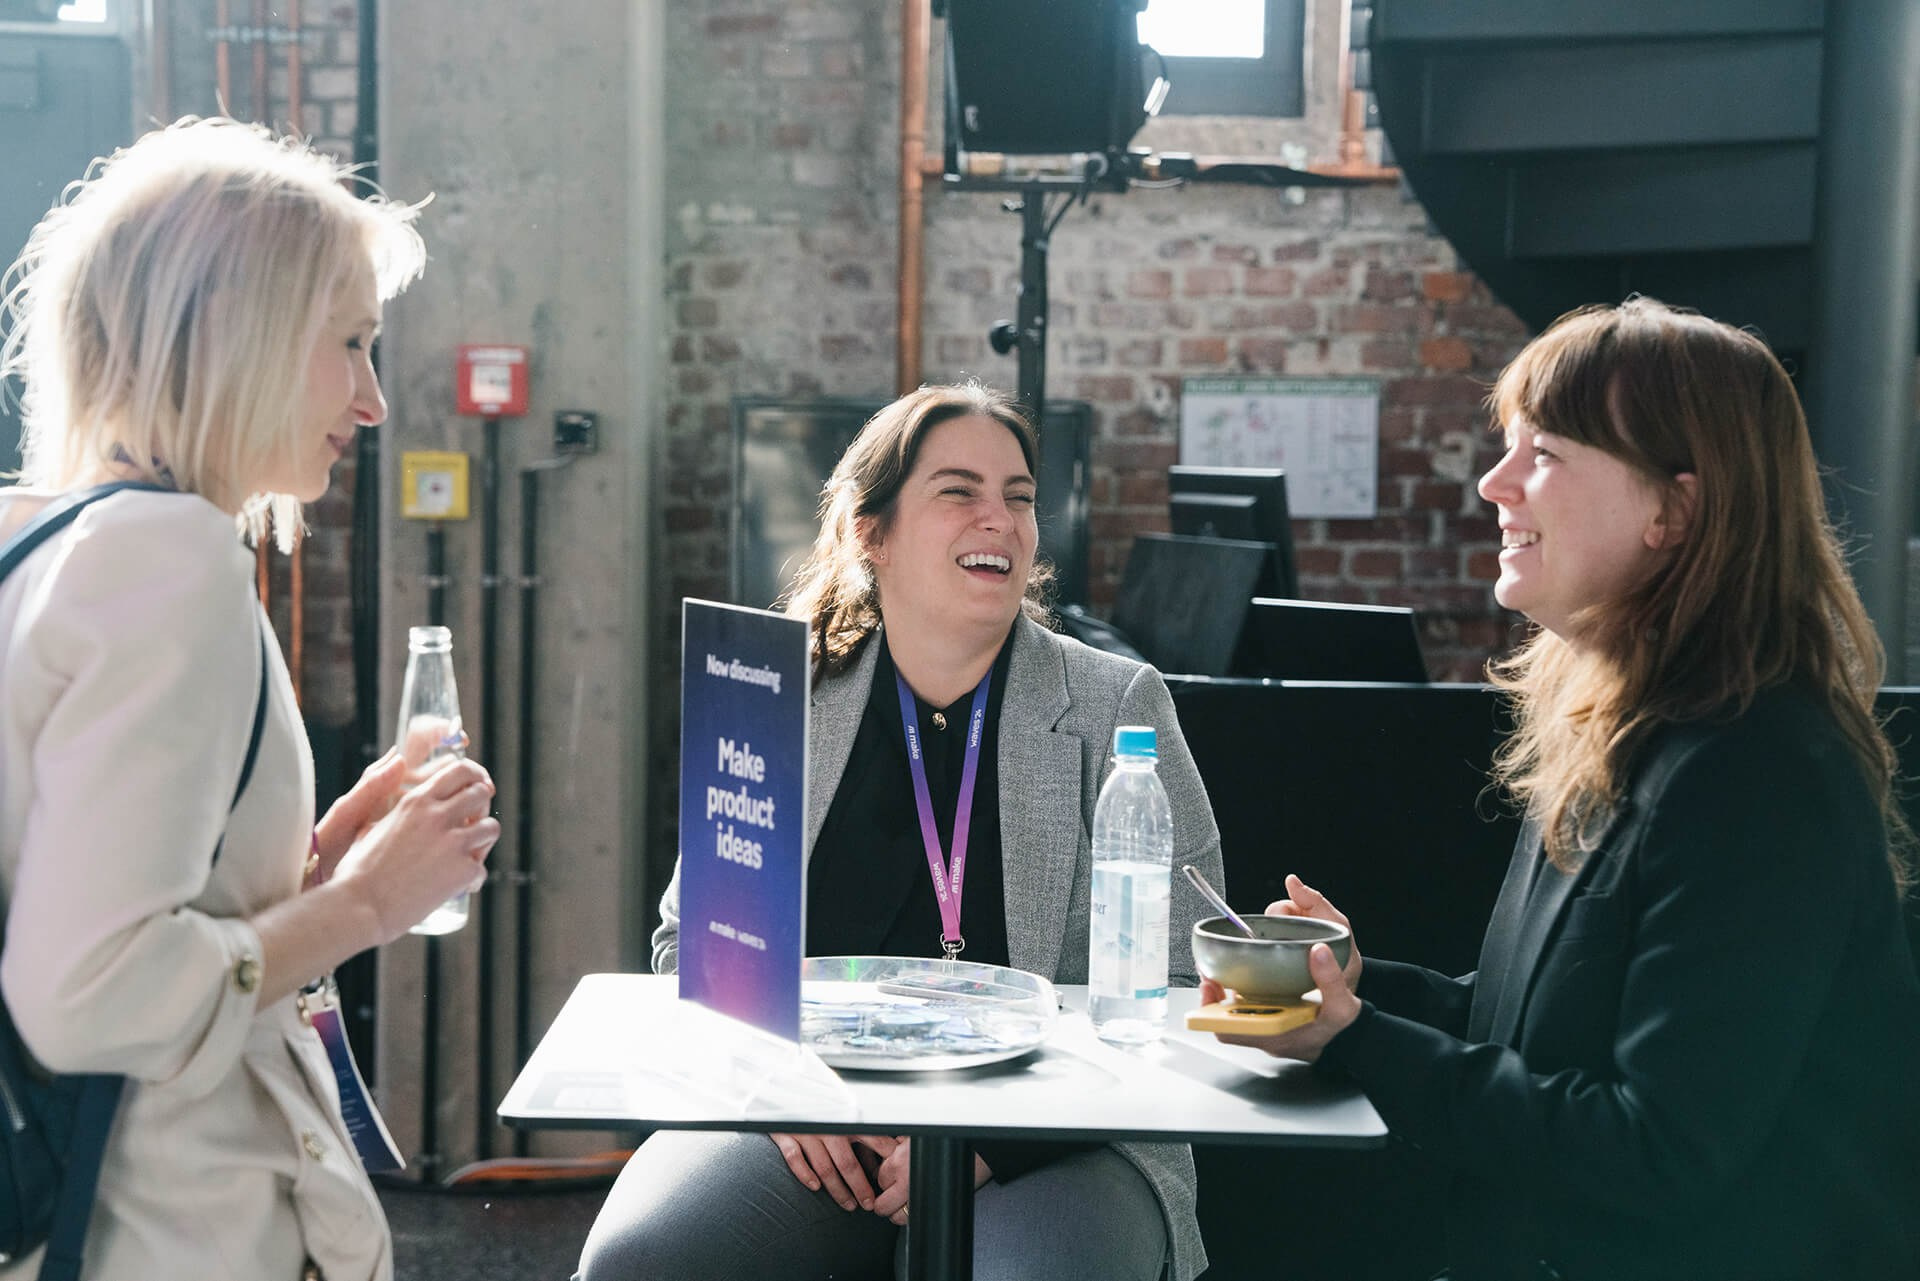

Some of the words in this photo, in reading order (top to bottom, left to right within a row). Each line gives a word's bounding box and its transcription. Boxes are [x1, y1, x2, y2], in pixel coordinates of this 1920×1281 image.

[706, 653, 729, 677] Now
[729, 658, 781, 694] discussing
[909, 734, 920, 760] make
[970, 719, 981, 748] waves
[718, 737, 765, 783] Make
[707, 785, 775, 830] product
[717, 822, 762, 870] ideas
[933, 862, 946, 892] waves
[952, 856, 962, 885] make
